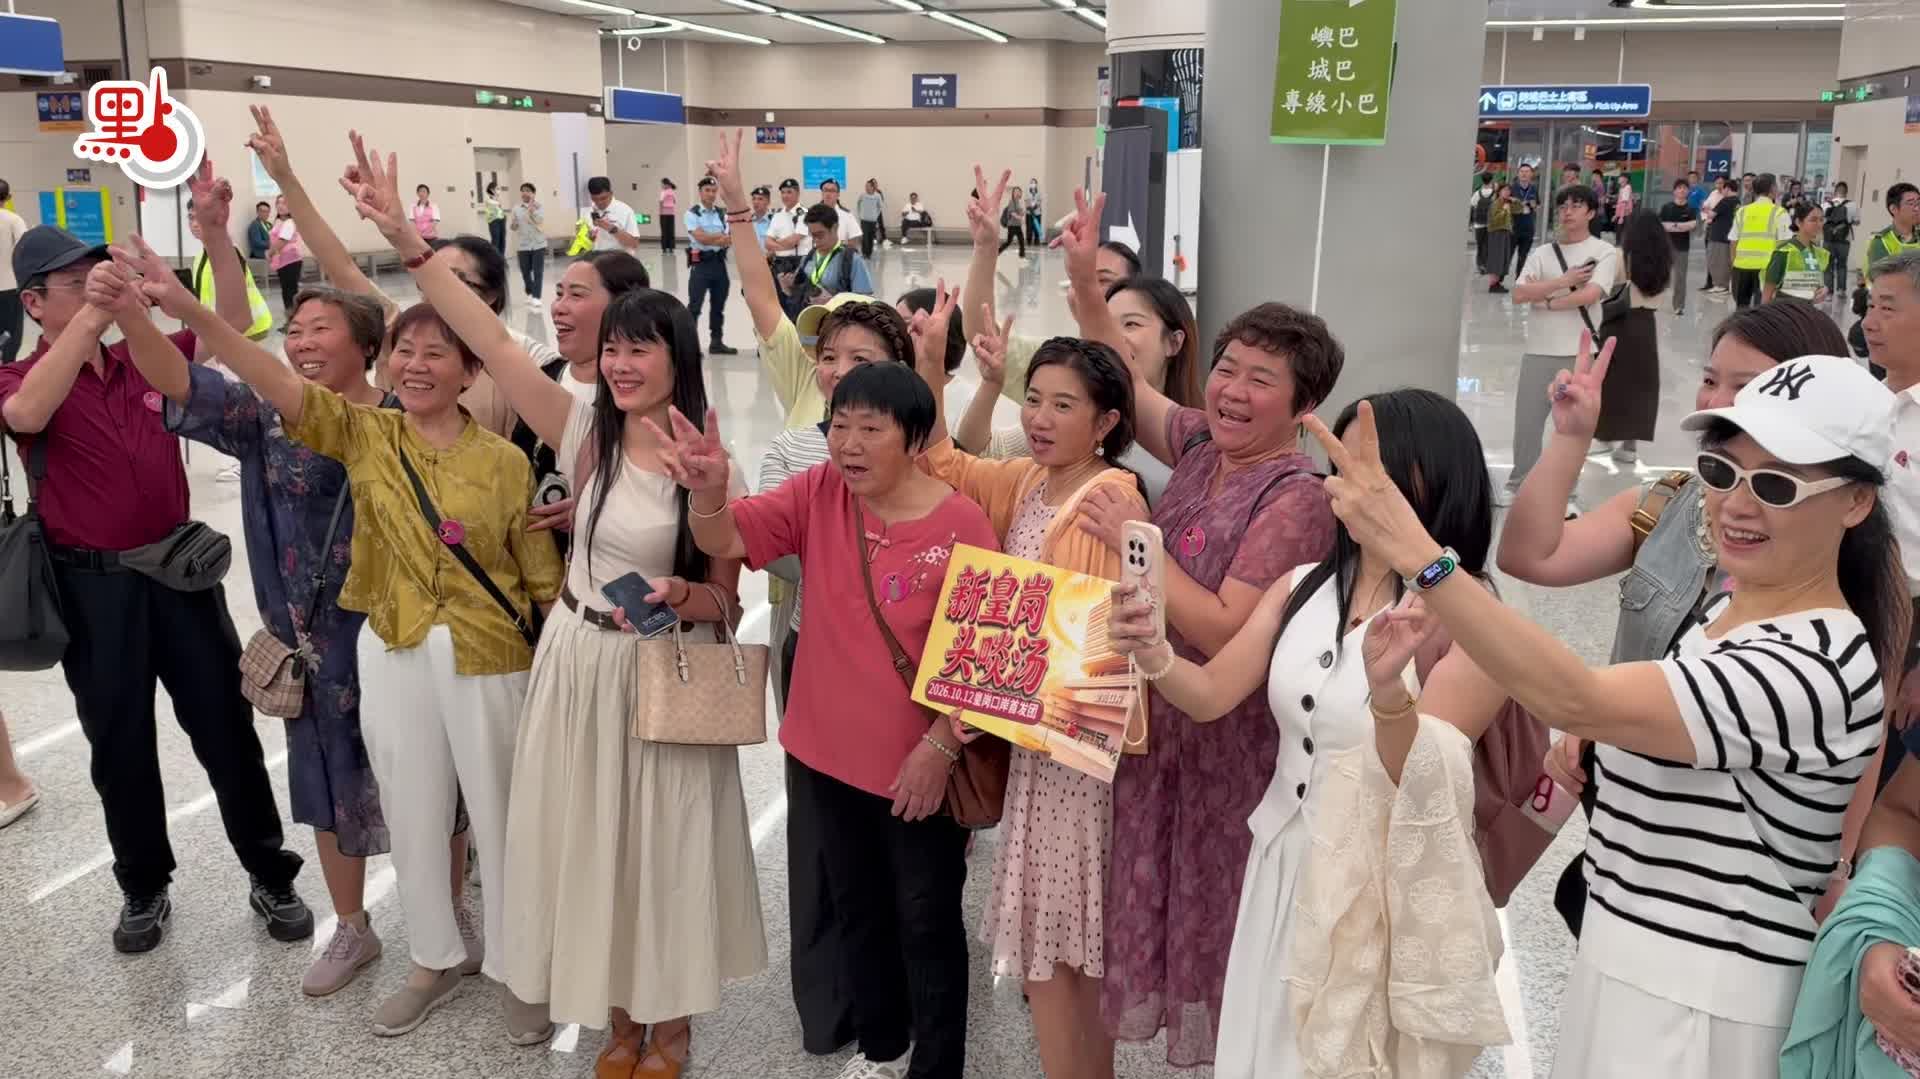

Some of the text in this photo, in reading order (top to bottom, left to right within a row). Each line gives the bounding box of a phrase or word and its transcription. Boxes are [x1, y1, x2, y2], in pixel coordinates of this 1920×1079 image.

[1311, 25, 1359, 48] 嶼巴
[1307, 57, 1356, 82] 城巴
[1281, 89, 1379, 115] 專線小巴
[1707, 159, 1728, 172] L2
[1759, 363, 1815, 401] NY
[944, 565, 1054, 634] 新皇岗
[940, 626, 1049, 696] 头啖汤
